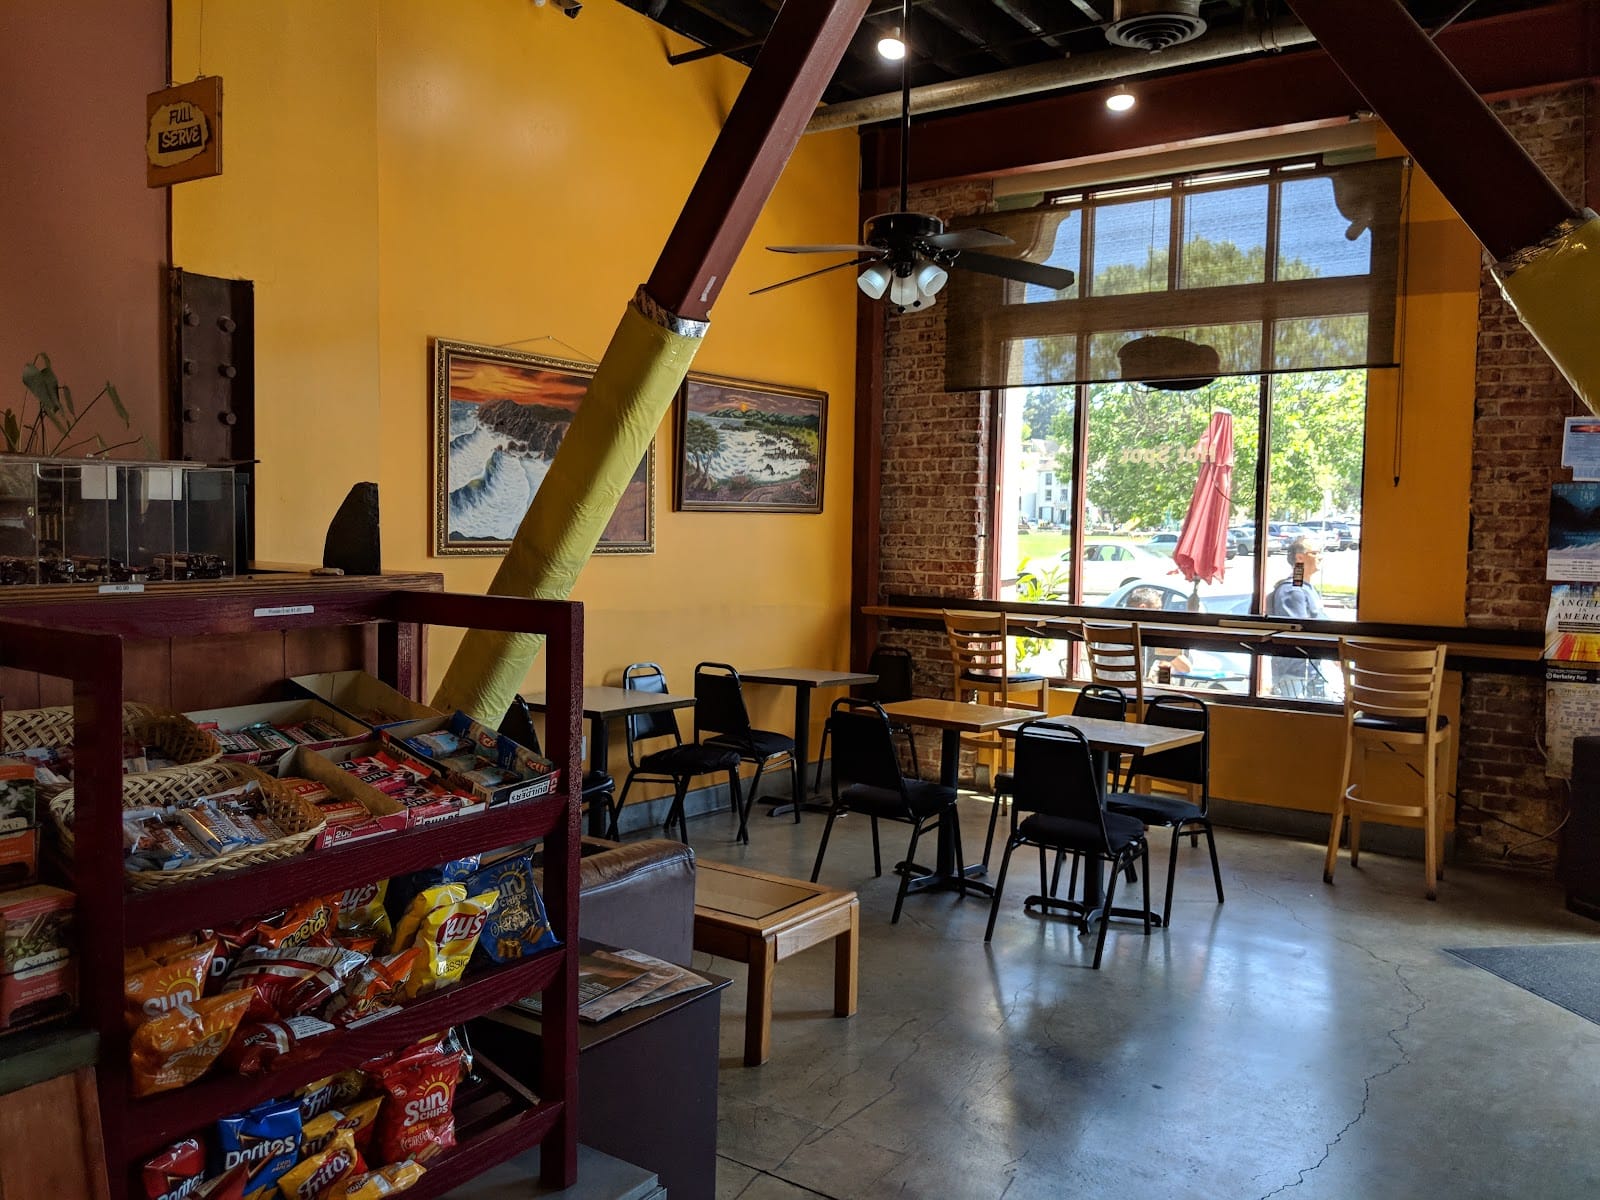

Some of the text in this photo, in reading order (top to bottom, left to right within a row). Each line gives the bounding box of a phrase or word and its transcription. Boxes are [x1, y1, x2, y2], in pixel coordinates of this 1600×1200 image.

[169, 106, 193, 125] FULL
[161, 126, 201, 149] SERVE
[403, 1090, 450, 1127] Sun
[418, 1104, 449, 1121] CHIPS
[225, 1134, 297, 1171] Doritos
[297, 1148, 351, 1200] Fritos
